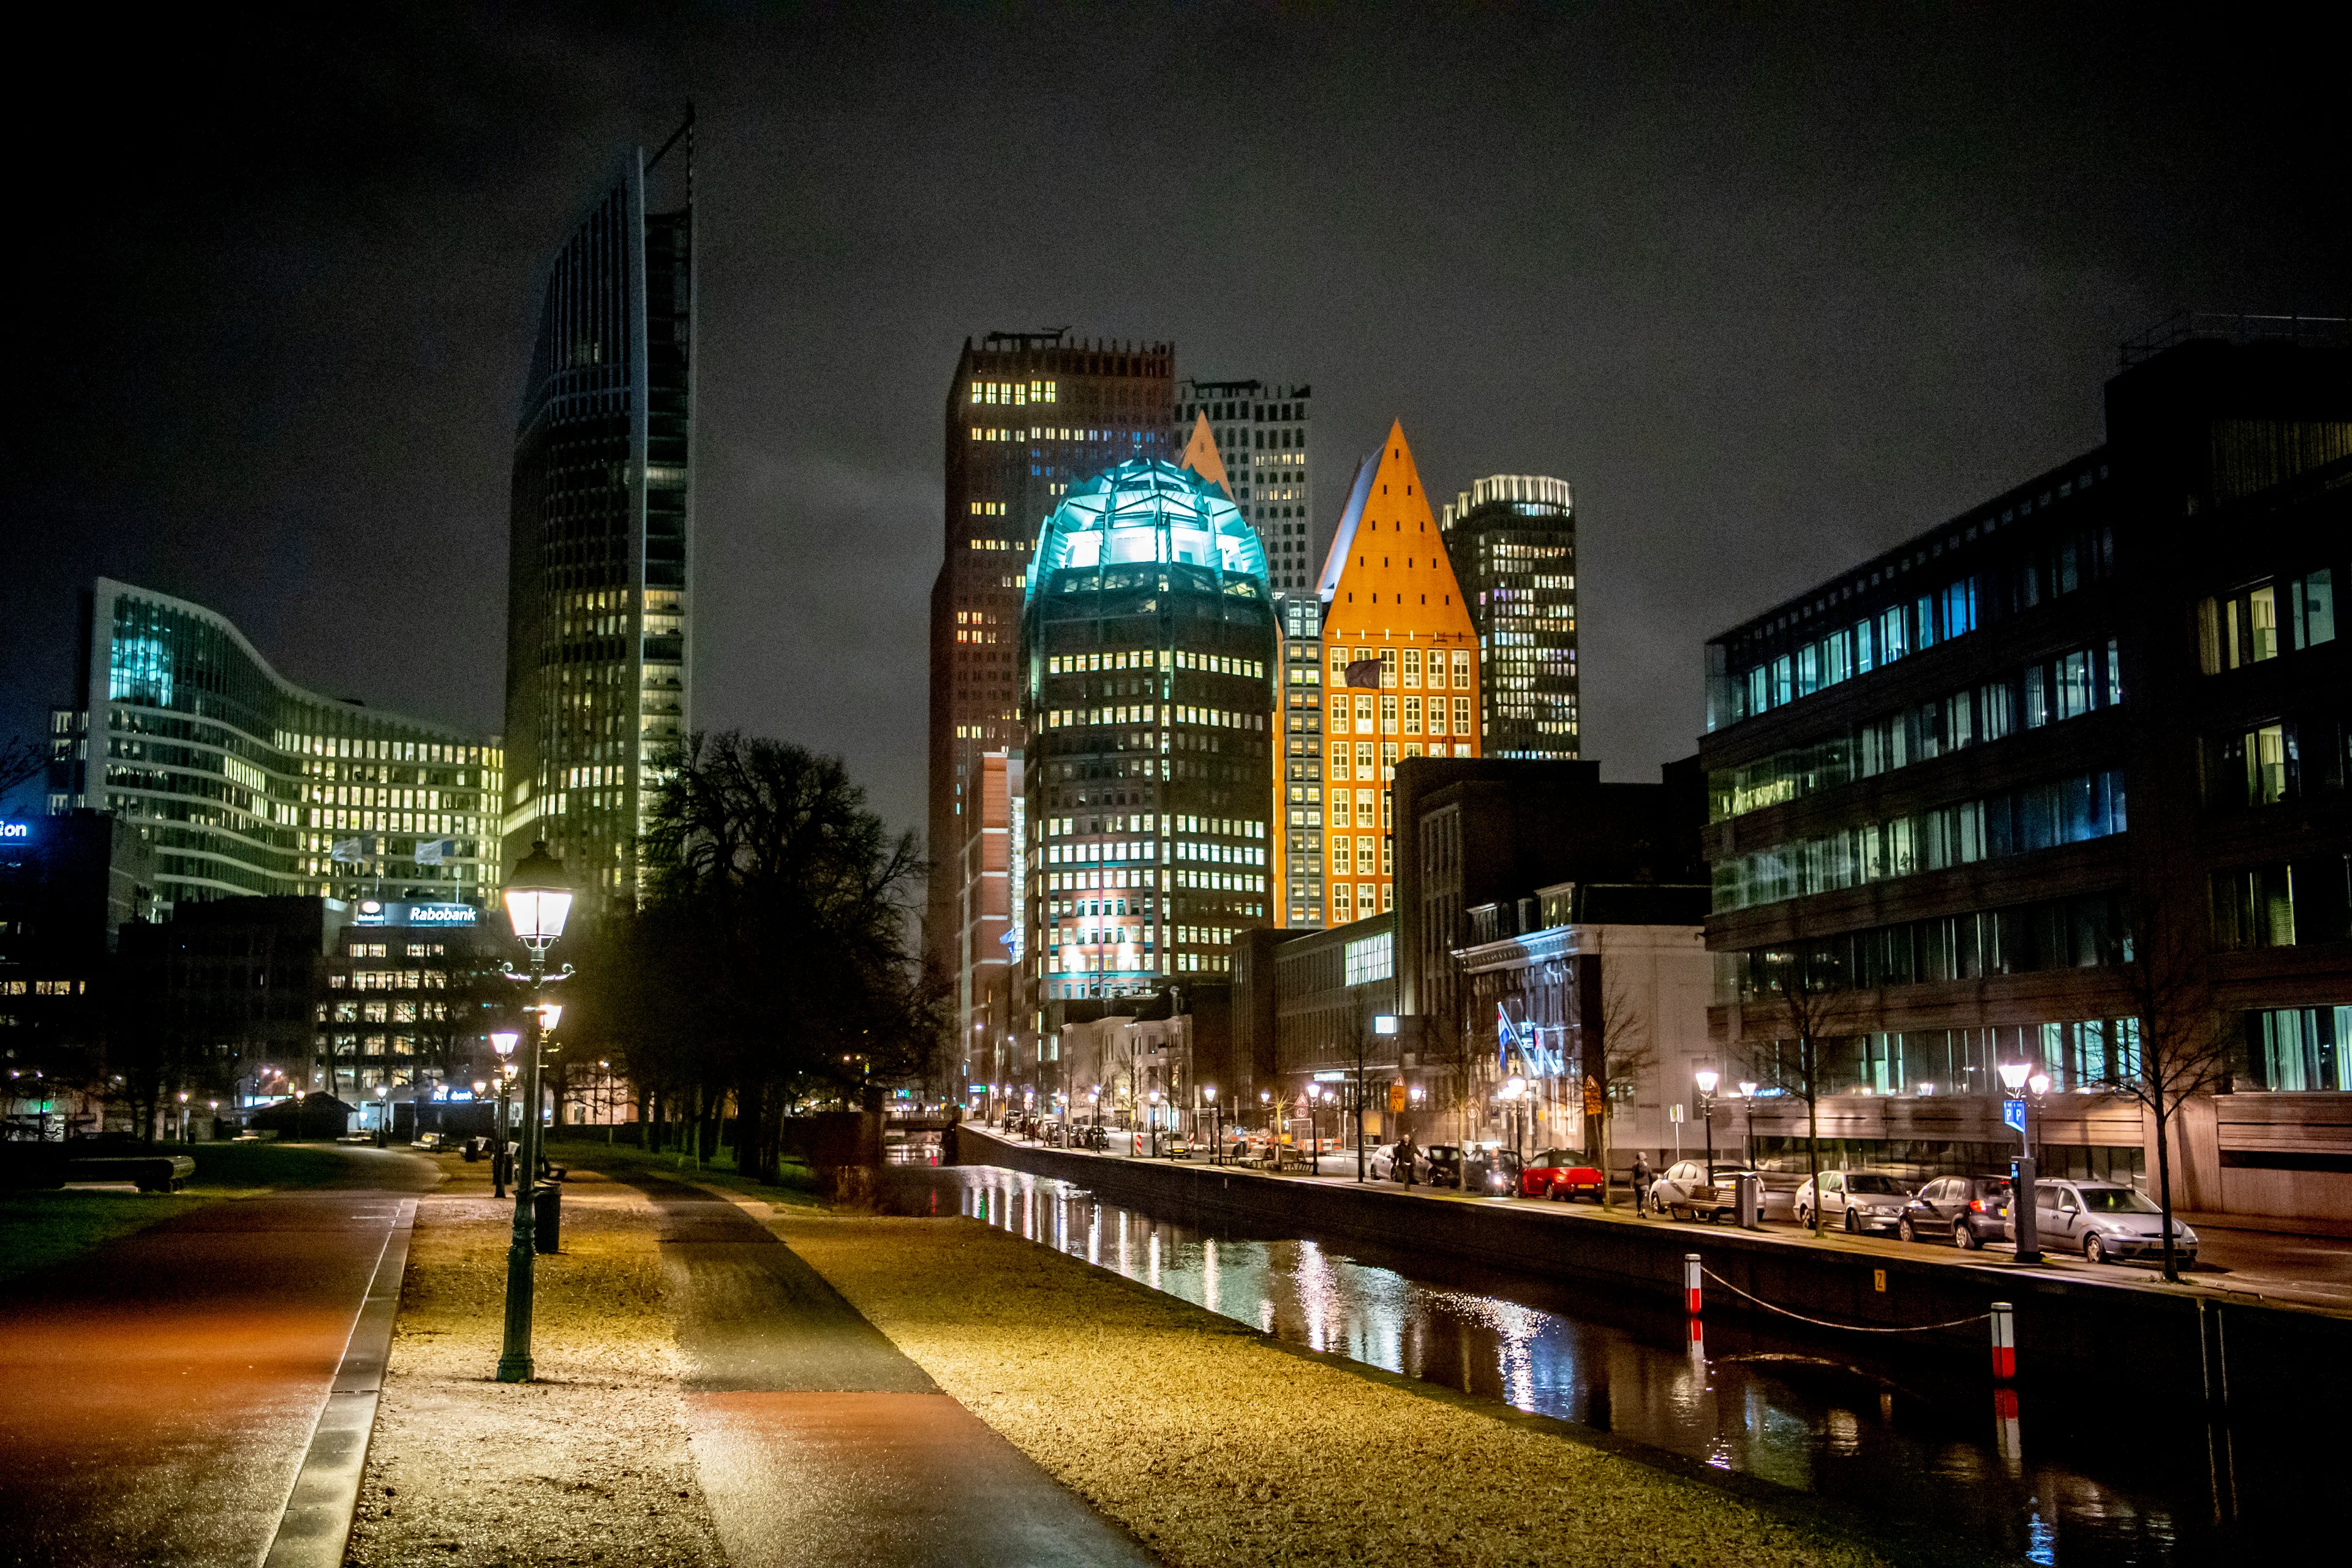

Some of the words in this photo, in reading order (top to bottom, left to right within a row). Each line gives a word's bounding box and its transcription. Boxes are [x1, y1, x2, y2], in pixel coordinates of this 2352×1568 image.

[410, 907, 477, 921] Rabobank
[2006, 1109, 2012, 1121] P
[2016, 1109, 2021, 1121] P
